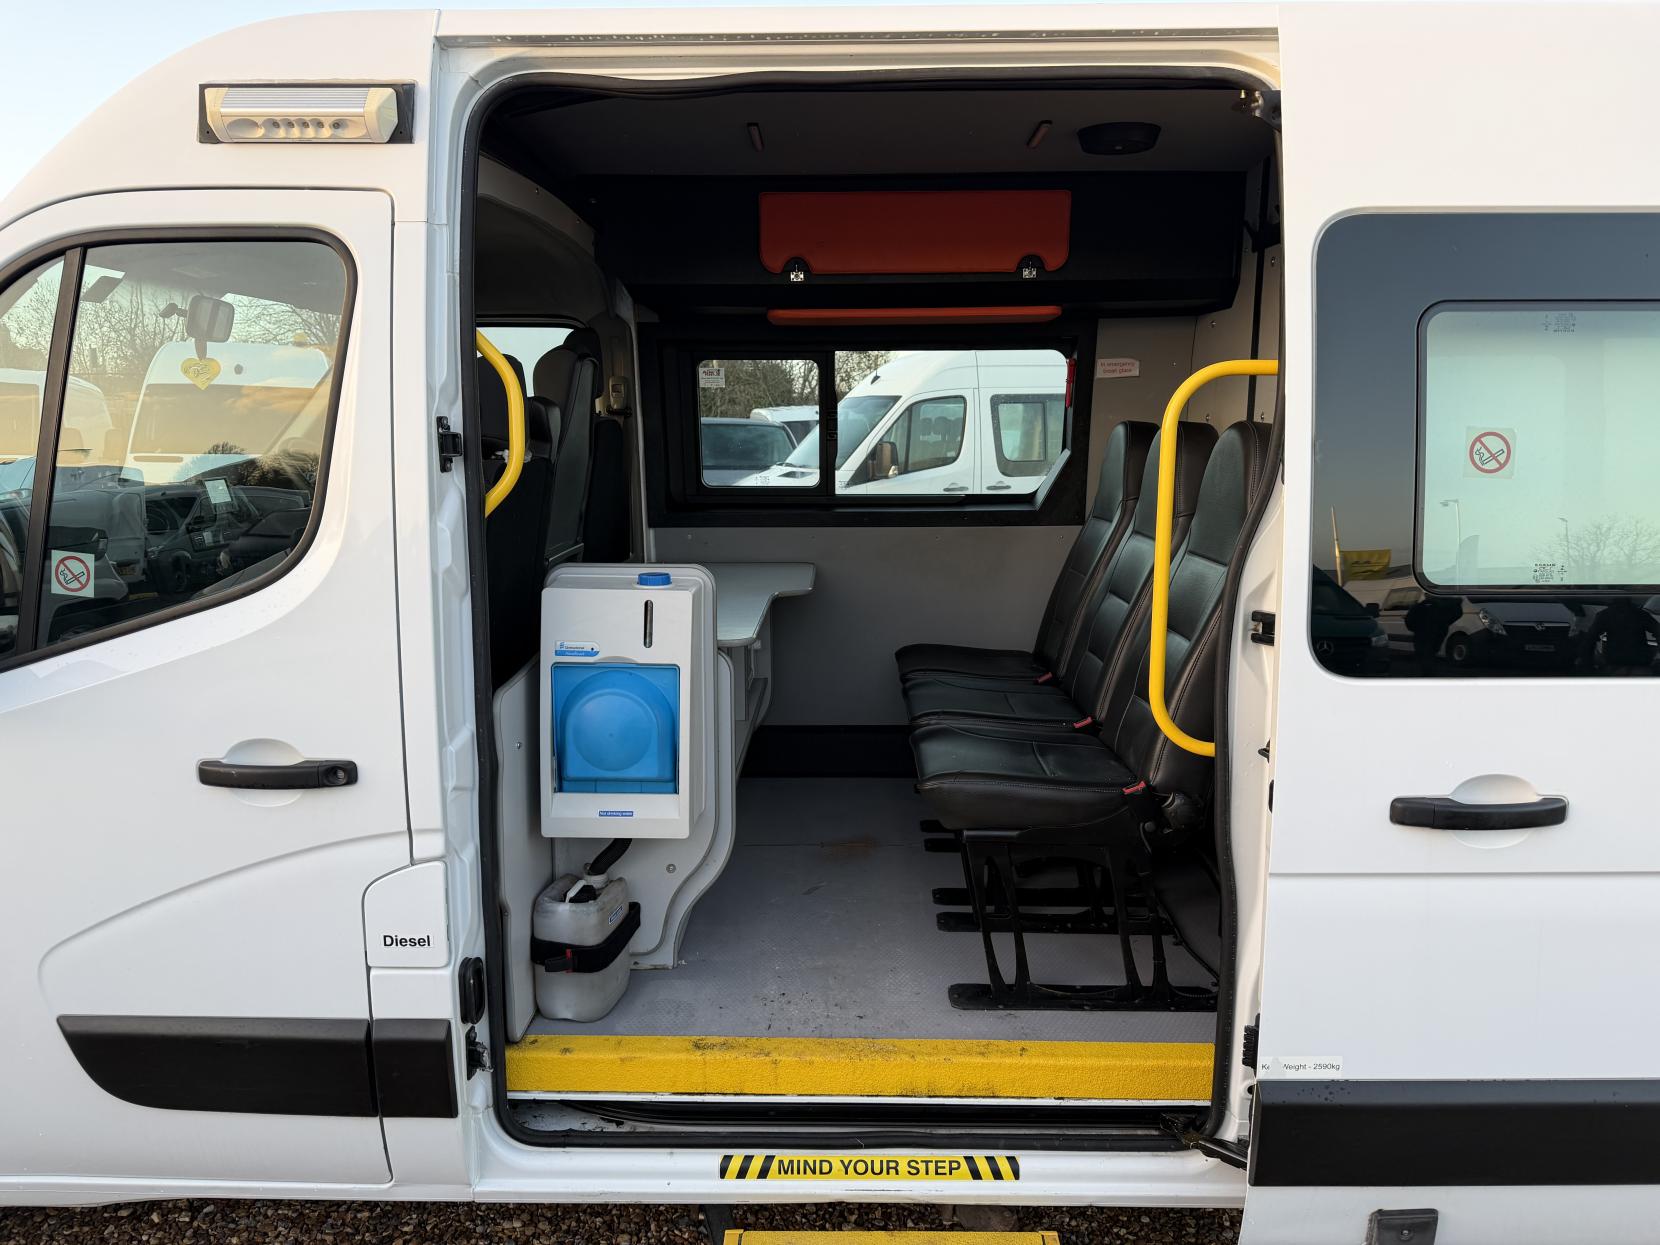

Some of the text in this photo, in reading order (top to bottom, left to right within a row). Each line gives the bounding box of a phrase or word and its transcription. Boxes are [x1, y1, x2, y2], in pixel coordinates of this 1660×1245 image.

[383, 934, 431, 947] Diesel
[1313, 1063, 1341, 1071] 2590kg
[778, 1159, 962, 1176] MIND YOUR STEP
